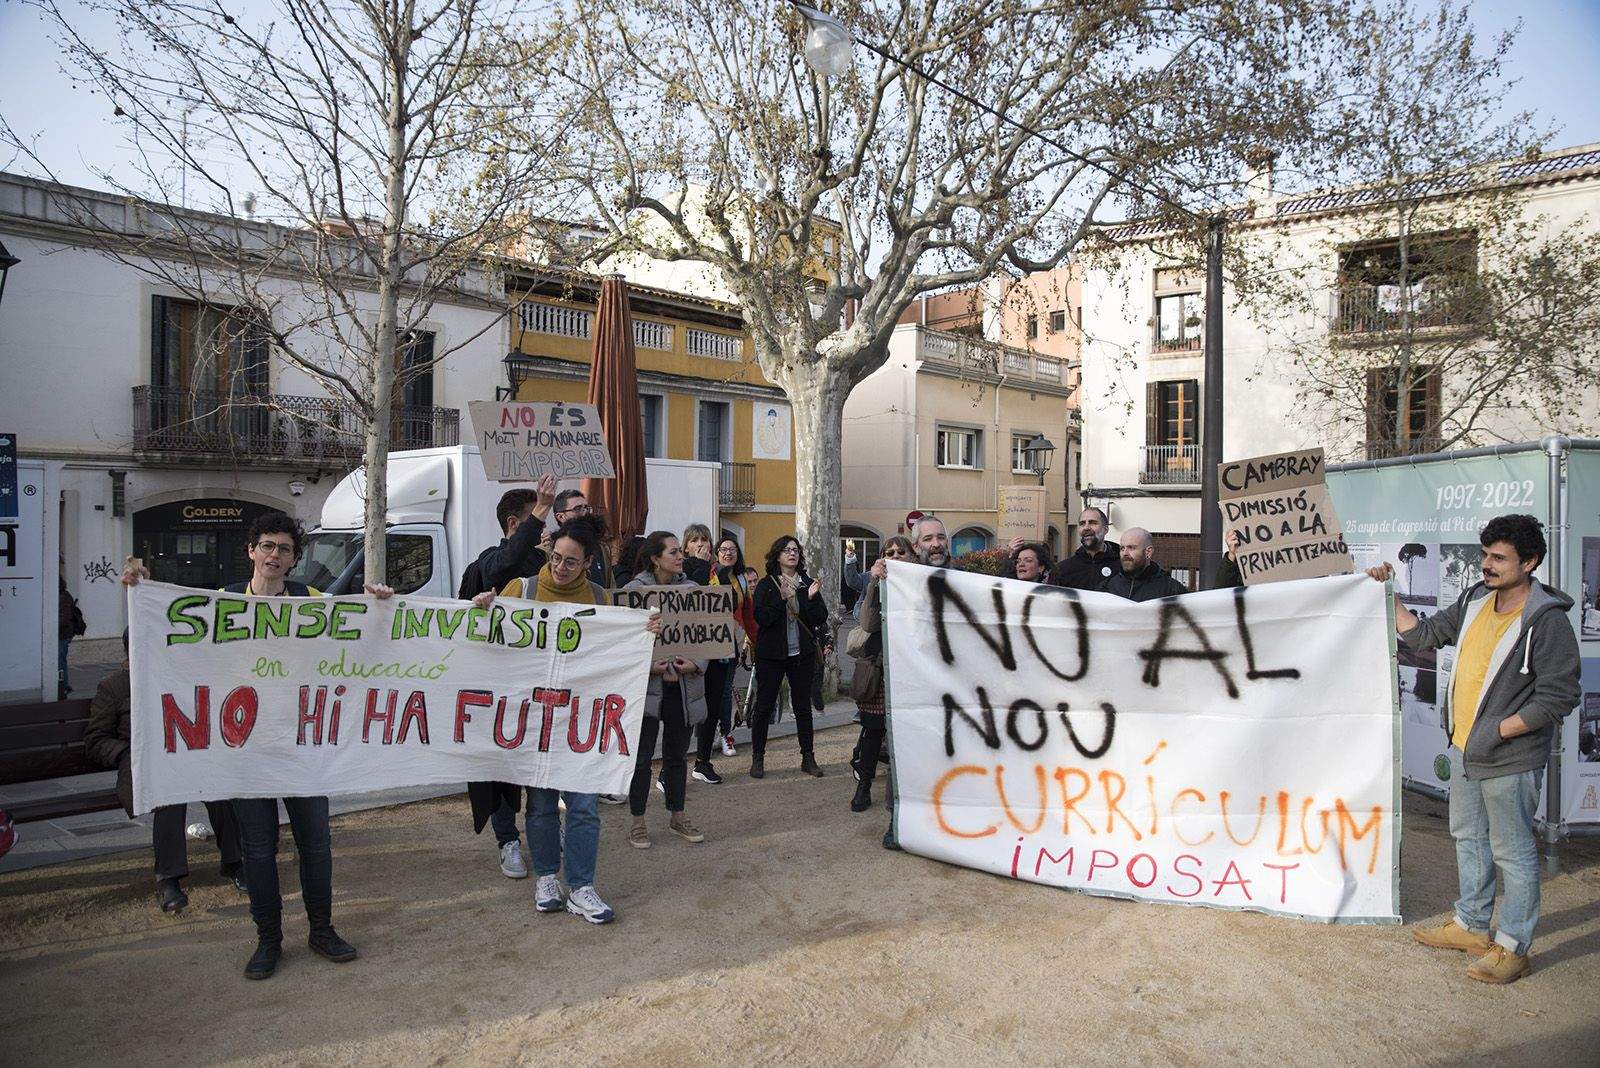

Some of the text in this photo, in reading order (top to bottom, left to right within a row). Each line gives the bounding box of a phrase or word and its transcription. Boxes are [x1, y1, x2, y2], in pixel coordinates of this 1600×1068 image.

[500, 402, 586, 429] NO ÉS
[501, 449, 610, 478] IMPOSAR
[1221, 455, 1322, 491] CAMBRAY
[183, 505, 243, 518] GOLDERY
[1224, 489, 1316, 522] DIMISSIÓ,
[1436, 479, 1535, 510] 1997-2022
[1233, 512, 1327, 547] NO A LA
[1345, 520, 1357, 533] 25
[1358, 522, 1378, 537] anys
[1379, 519, 1390, 533] de
[1440, 517, 1450, 532] al
[1452, 516, 1464, 531] Pi
[1239, 532, 1349, 580] PRIVATITZACIÓ
[167, 595, 367, 646] SENSE
[927, 569, 1302, 699] NO AL
[252, 648, 455, 680] en educació
[161, 685, 630, 756] NO Hi HA FUTUR
[943, 686, 1116, 759] NOU
[931, 741, 1383, 875] CURRÍCULUM
